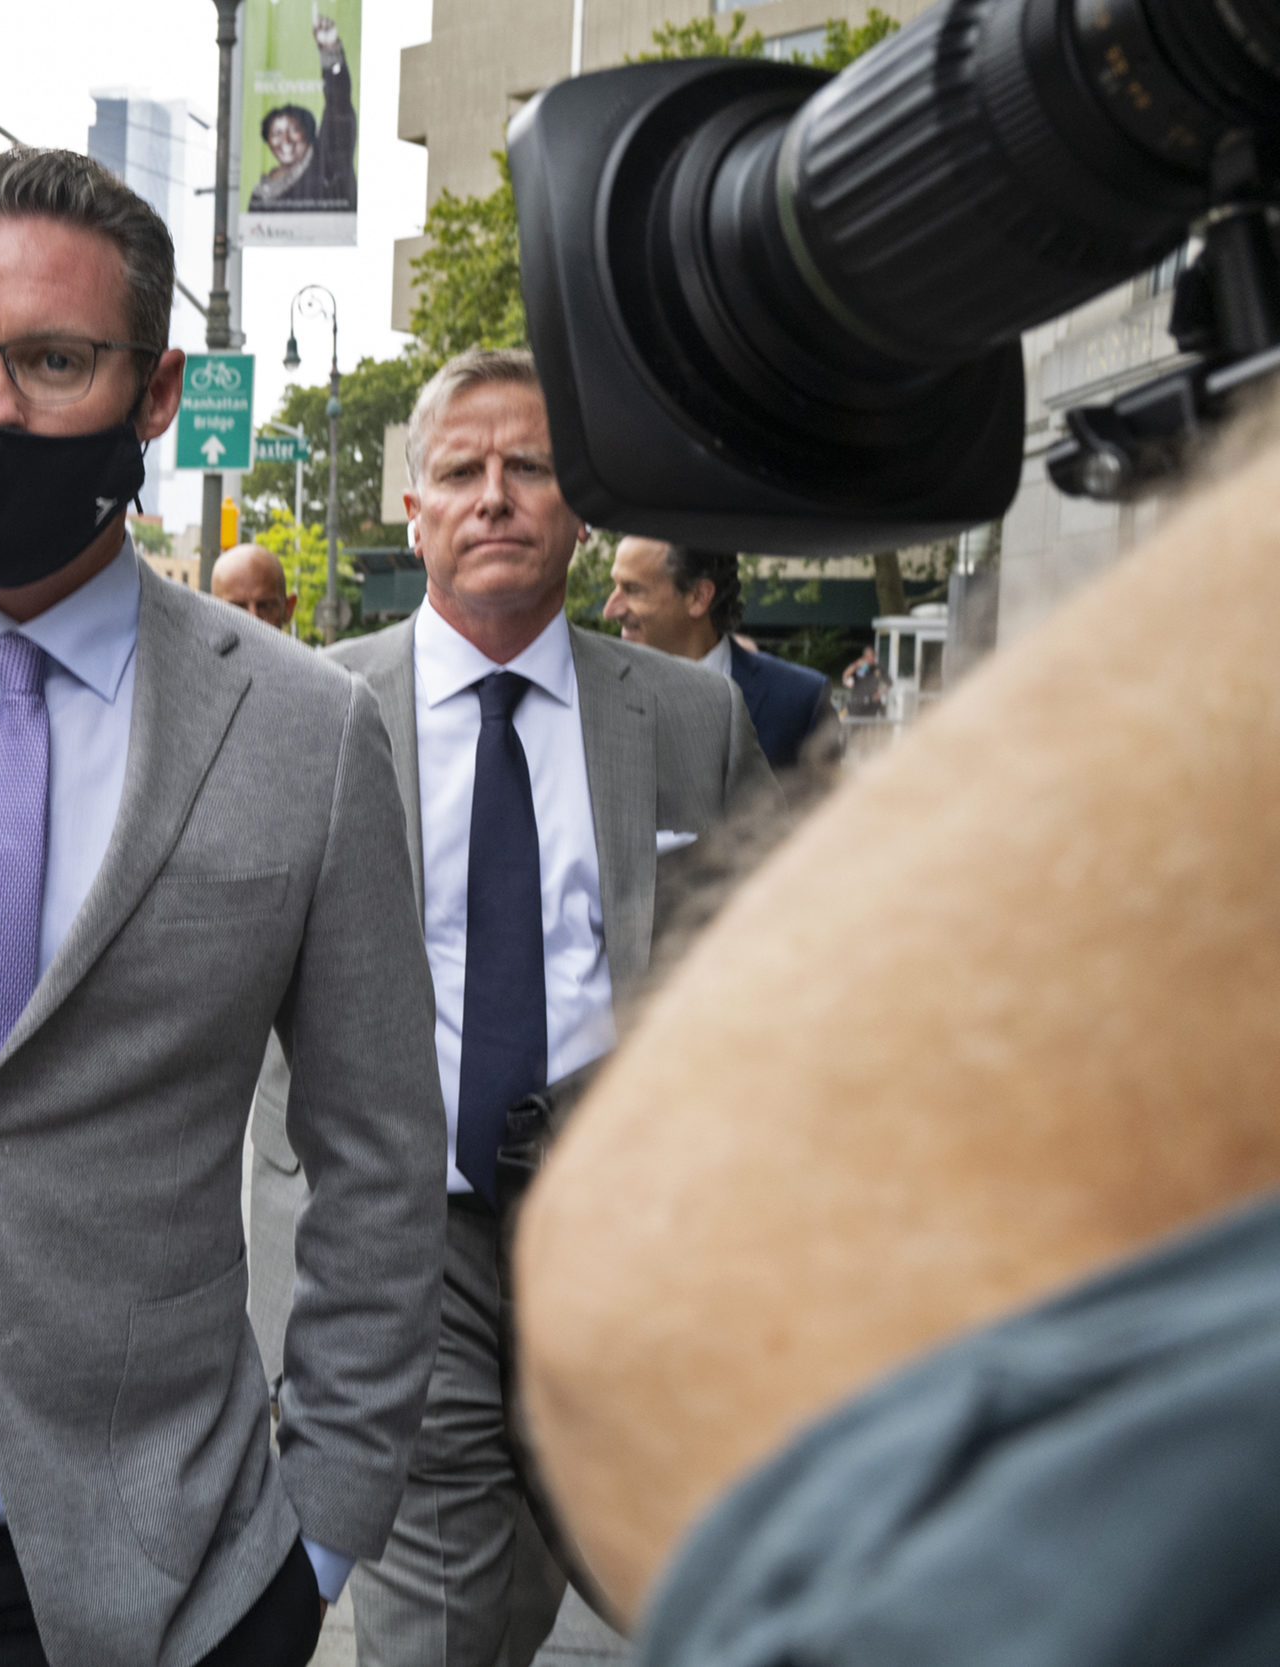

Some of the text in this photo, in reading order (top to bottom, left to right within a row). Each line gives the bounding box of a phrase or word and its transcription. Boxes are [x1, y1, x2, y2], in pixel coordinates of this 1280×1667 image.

[182, 396, 249, 411] Manhattan
[193, 416, 235, 433] Bridge
[254, 441, 294, 459] axter
